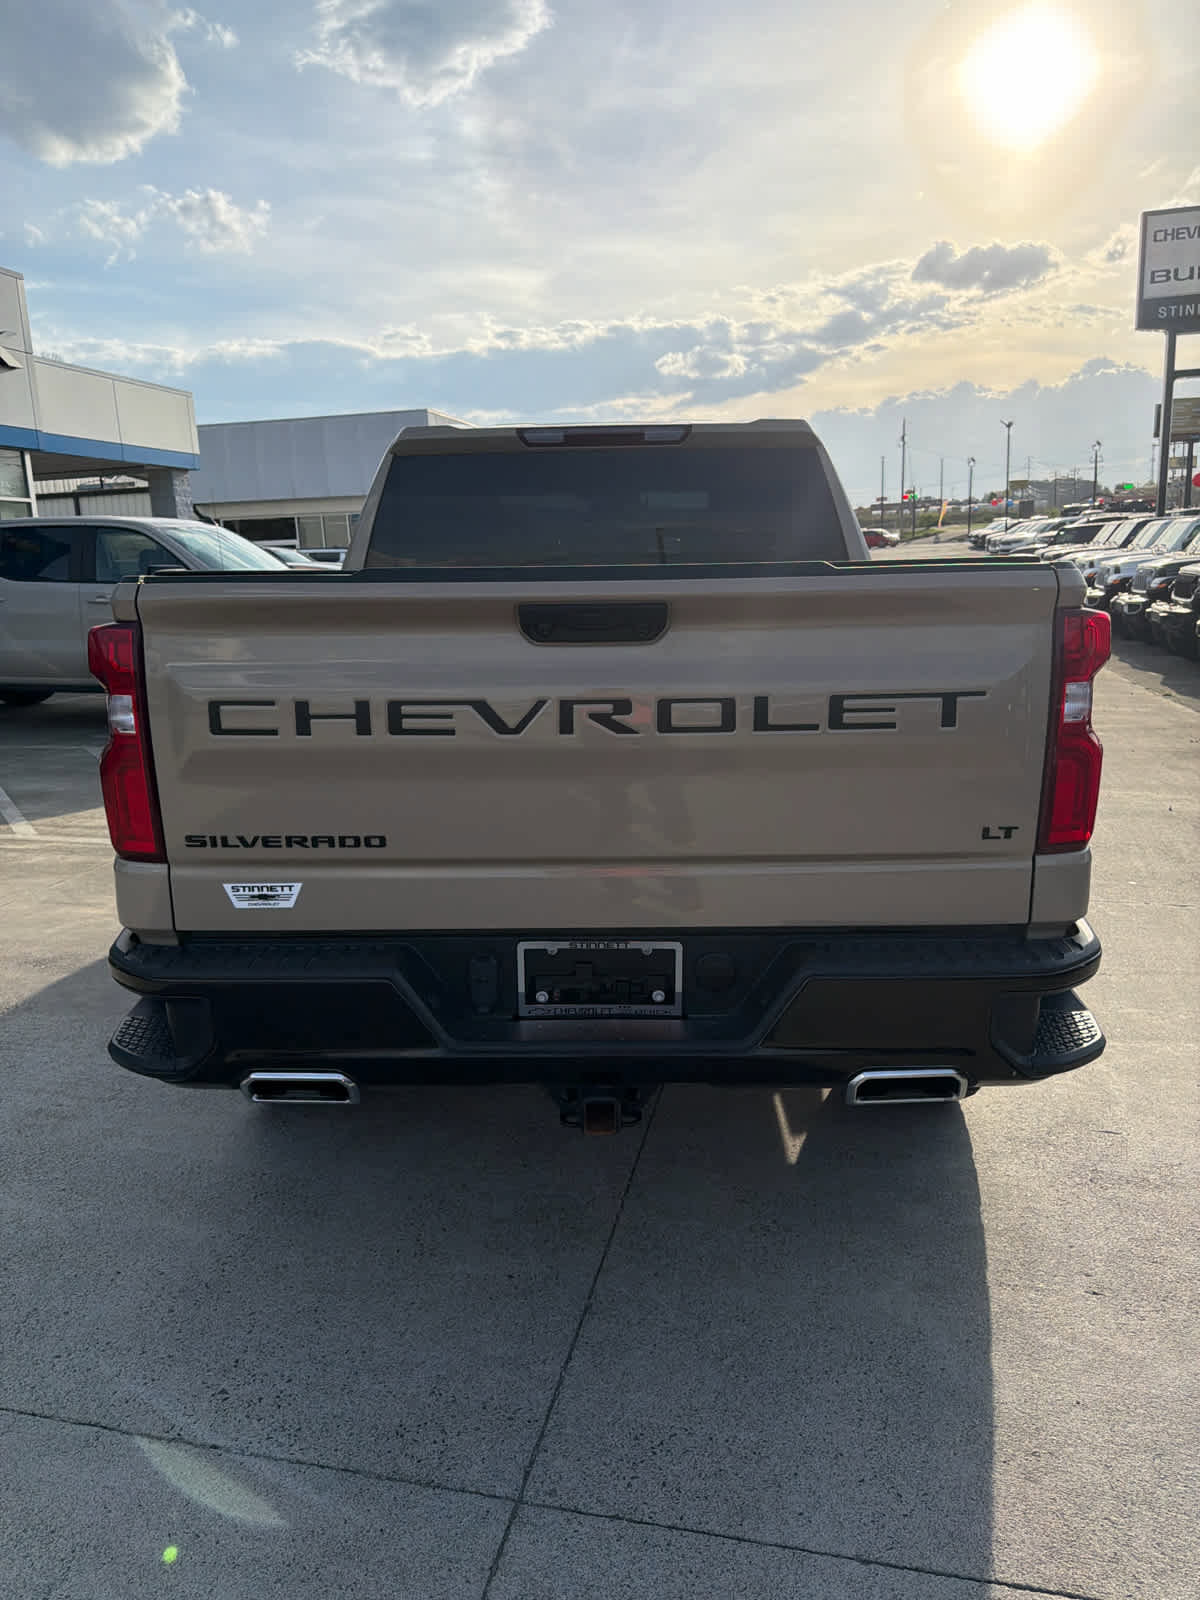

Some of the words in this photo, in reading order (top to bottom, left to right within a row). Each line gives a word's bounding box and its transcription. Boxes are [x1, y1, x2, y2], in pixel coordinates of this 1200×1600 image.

[1153, 225, 1200, 243] CHEV
[1158, 303, 1200, 319] STIN
[208, 690, 987, 737] CHEVROLET
[981, 826, 1019, 840] LT
[184, 834, 388, 849] SILVERADO
[230, 884, 296, 893] STINNETT
